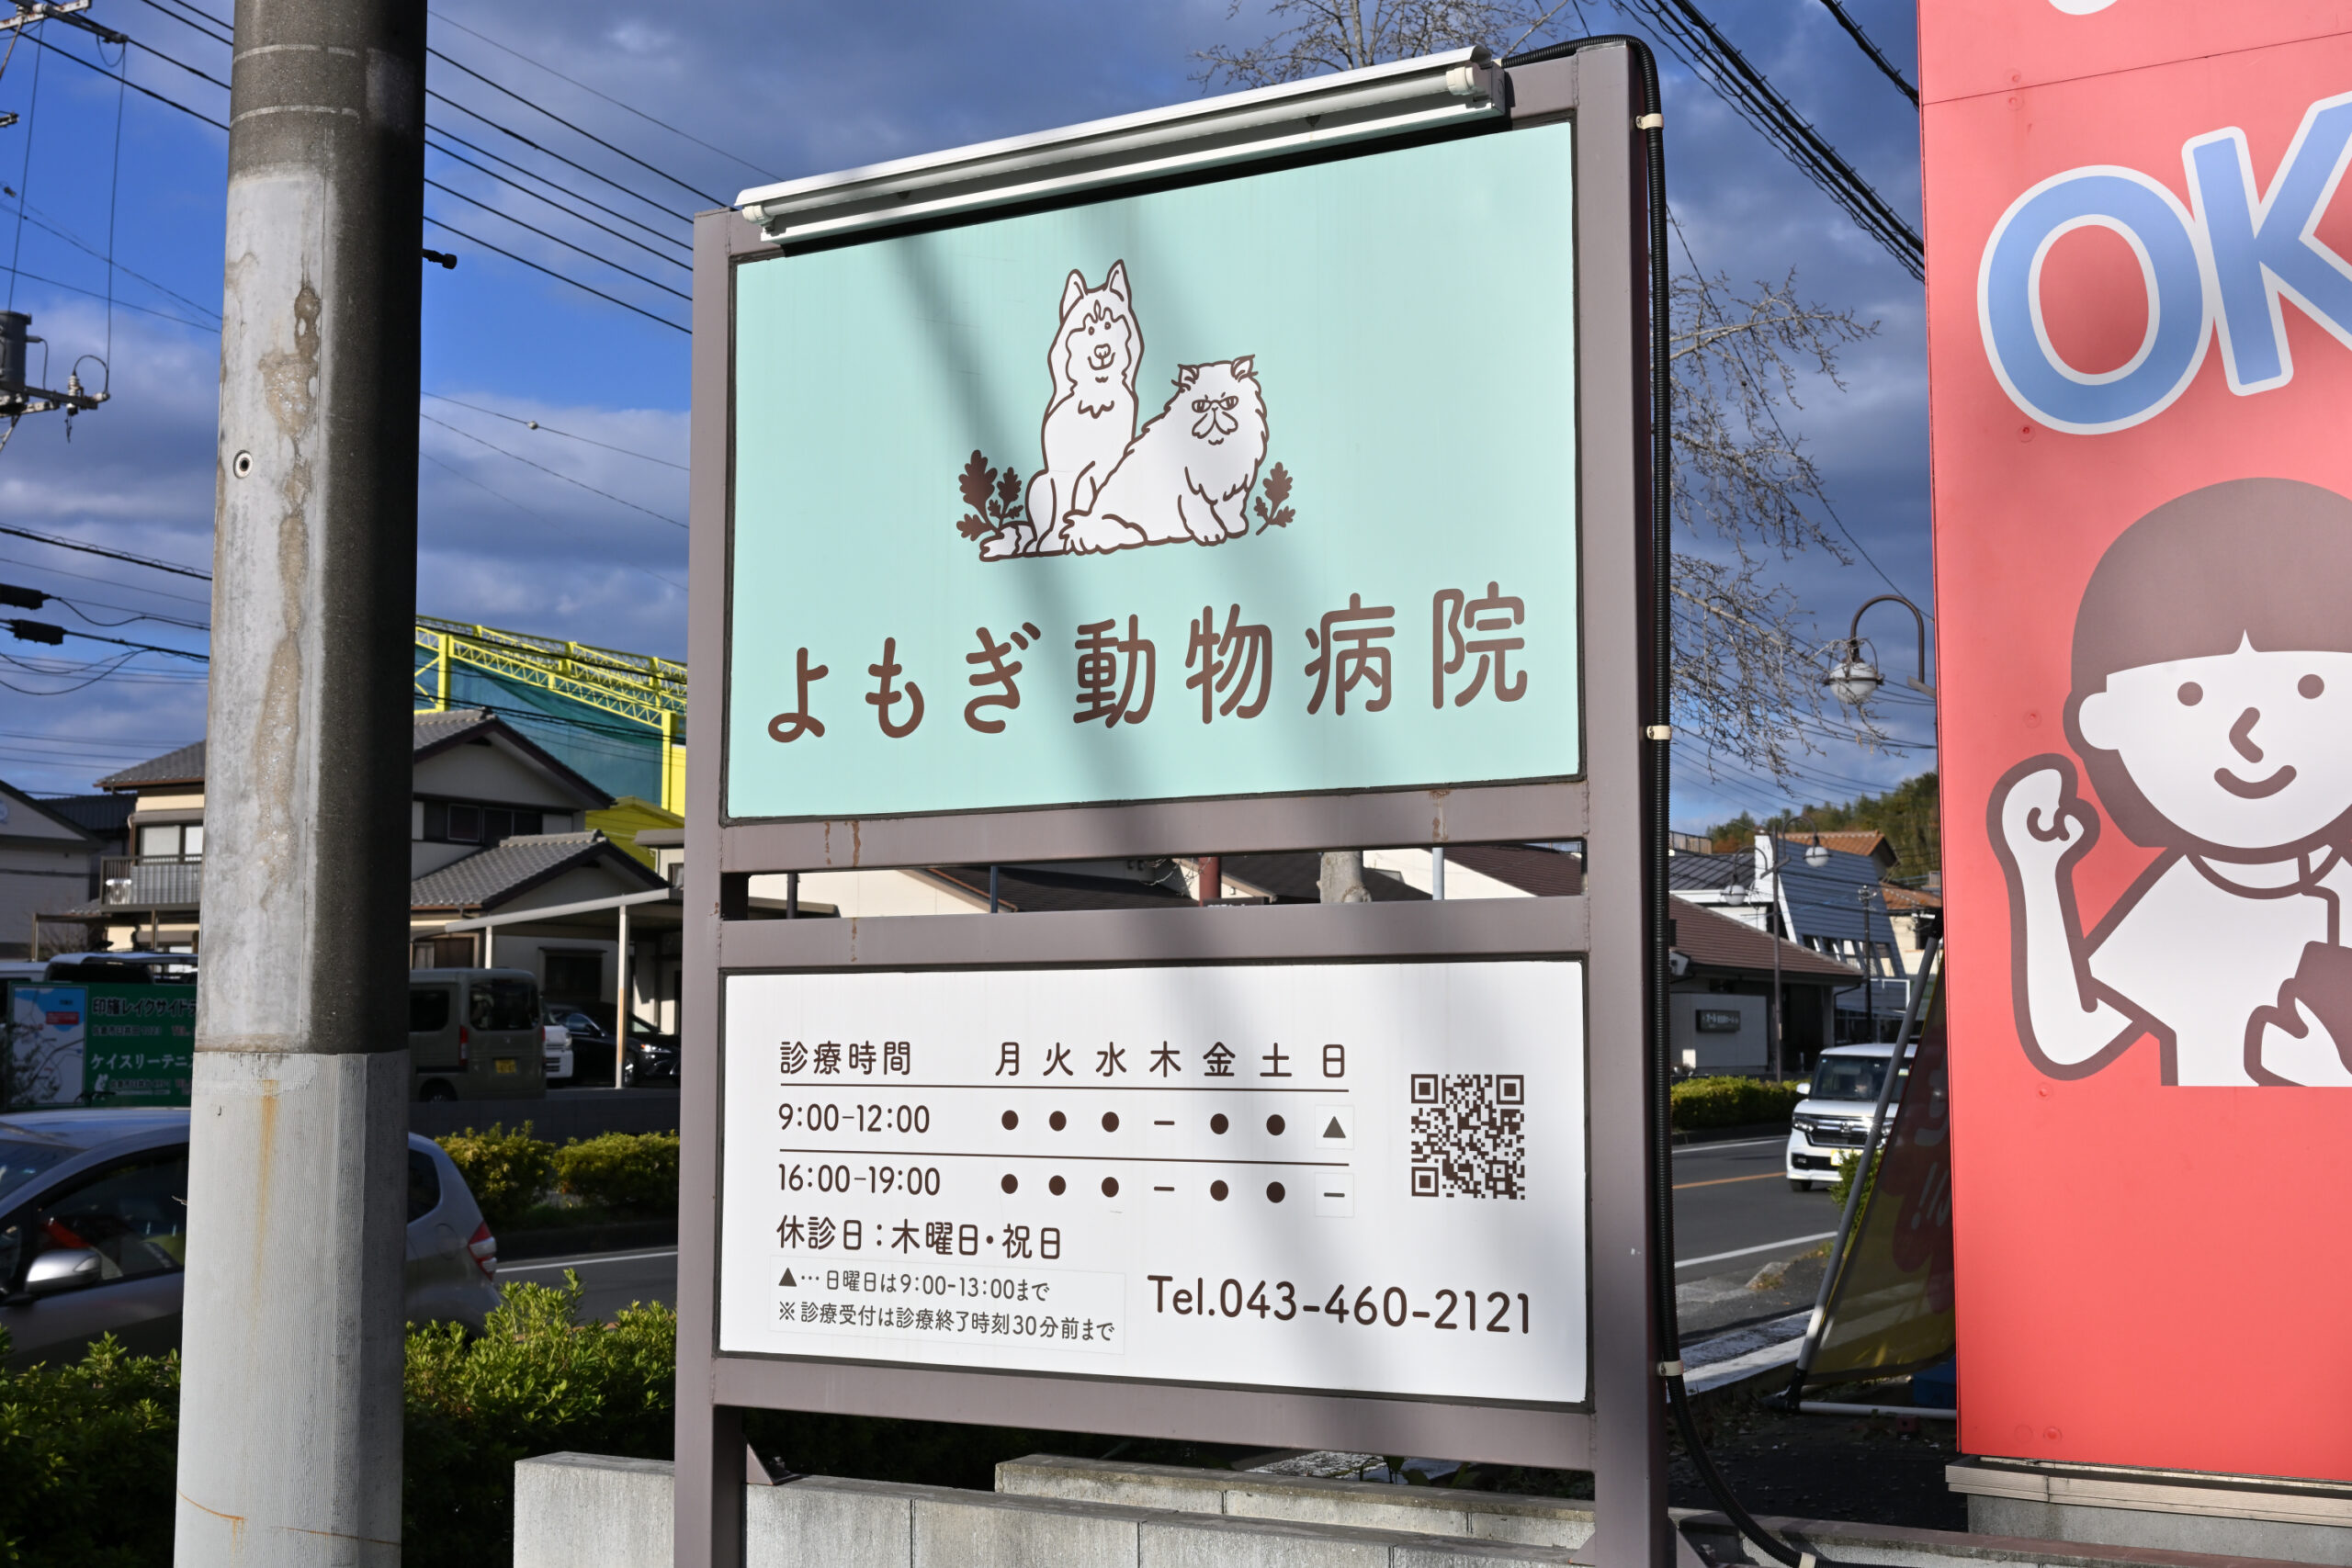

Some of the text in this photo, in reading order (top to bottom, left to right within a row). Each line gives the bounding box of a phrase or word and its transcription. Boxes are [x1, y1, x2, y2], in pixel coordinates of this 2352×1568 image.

[767, 581, 1528, 743] よもぎ動物病院
[779, 1040, 1345, 1078] 診療時間 月 火 水 木 金 土 日
[778, 1102, 930, 1134] 9:00-12:00
[778, 1163, 941, 1196] 16:00-19:00
[1147, 1274, 1530, 1335] Tel.043-460-2121
